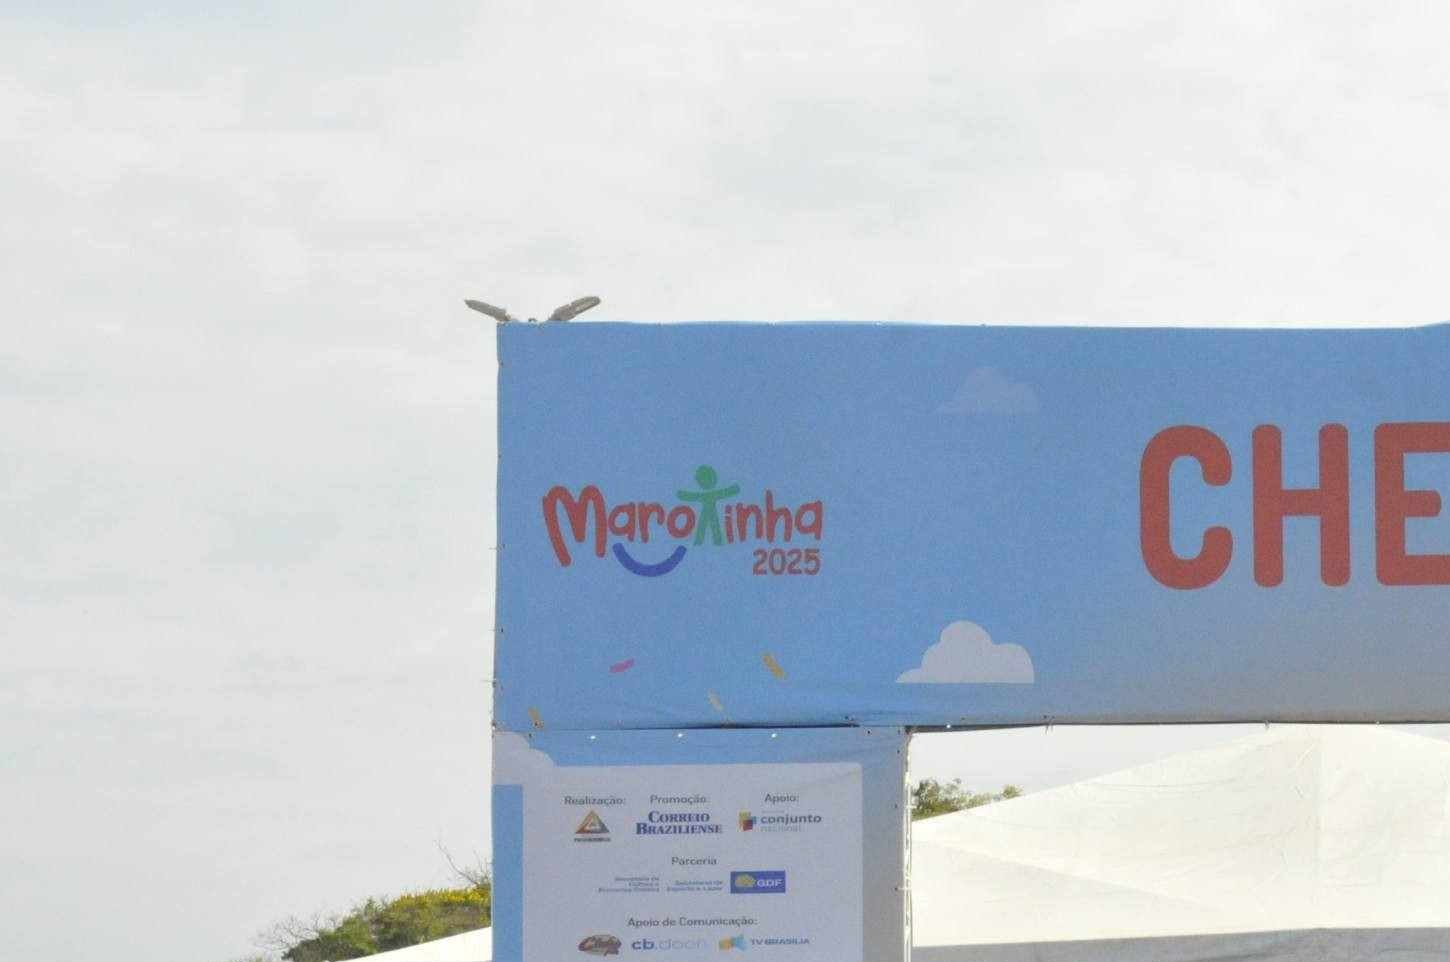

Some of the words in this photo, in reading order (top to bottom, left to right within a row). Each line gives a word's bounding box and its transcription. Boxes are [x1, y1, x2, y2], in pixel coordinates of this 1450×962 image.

[542, 465, 823, 567] Marotinha
[753, 548, 821, 576] 2025
[760, 815, 822, 826] conjunto
[636, 822, 723, 835] BRAZILIENSE
[672, 856, 718, 866] Parceria
[756, 879, 782, 888] GDF
[628, 917, 659, 929] Apoio
[662, 917, 676, 926] de
